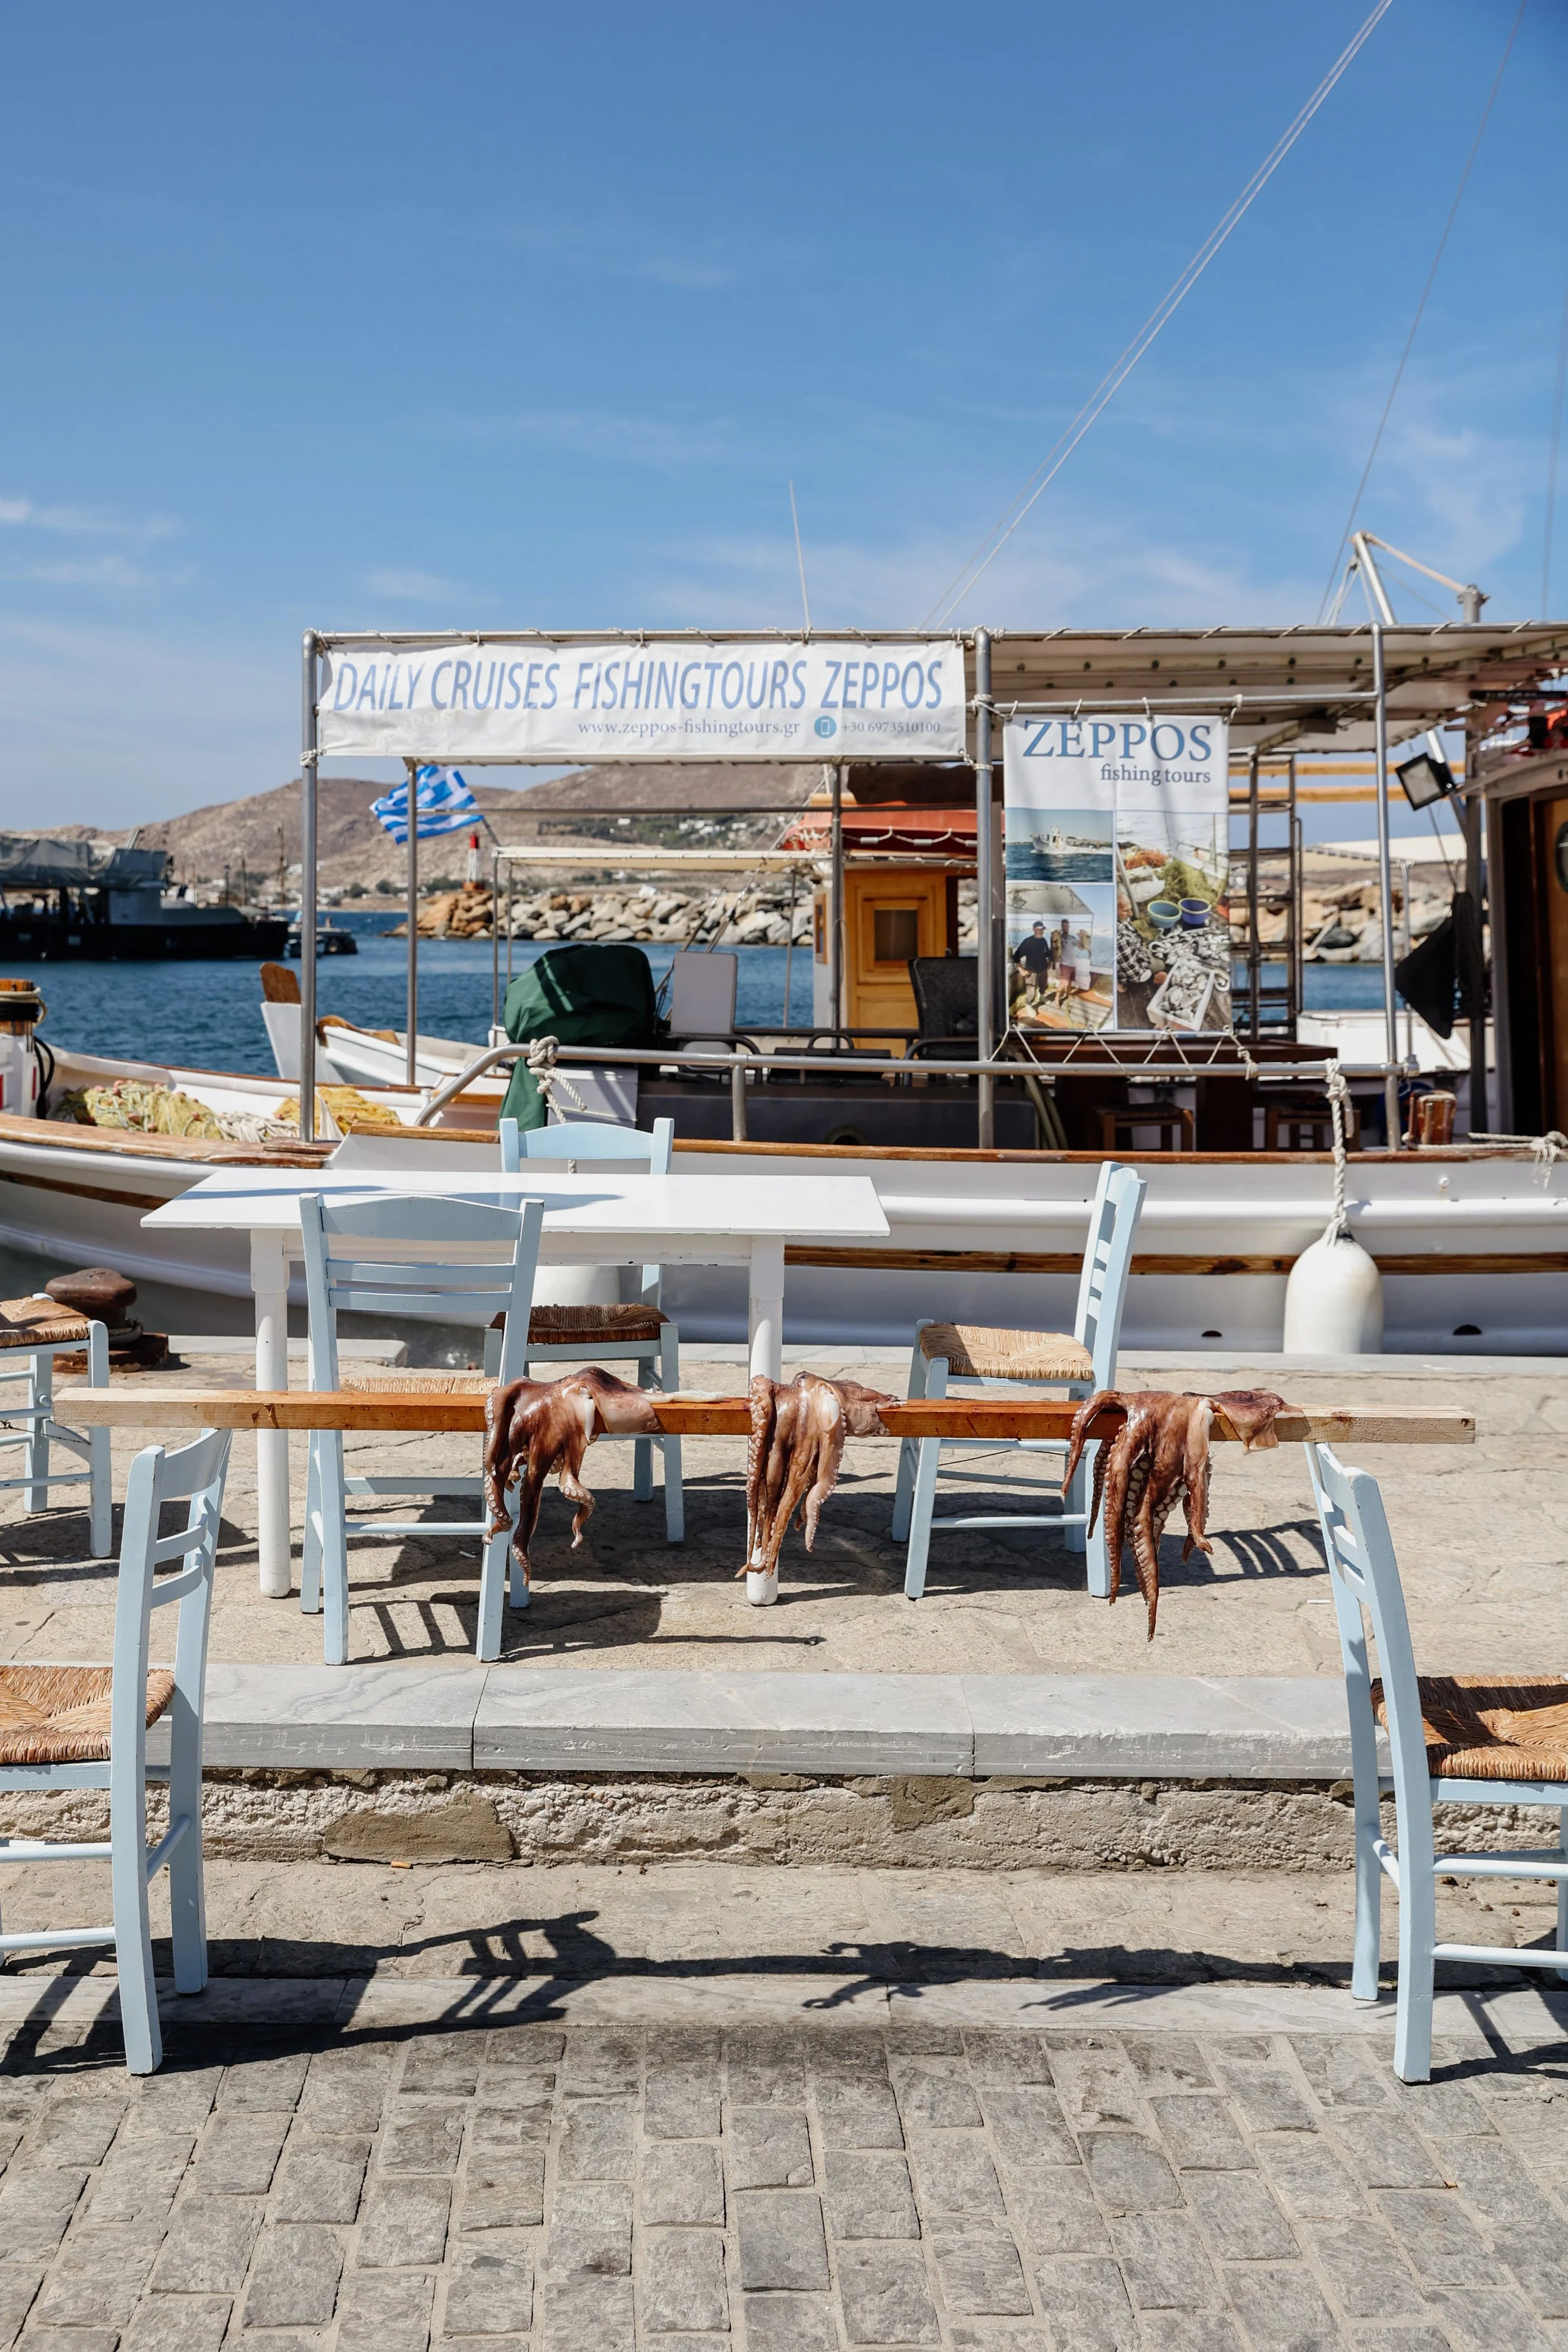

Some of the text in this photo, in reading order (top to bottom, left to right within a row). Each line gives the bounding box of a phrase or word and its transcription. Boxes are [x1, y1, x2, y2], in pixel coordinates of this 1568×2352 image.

[333, 660, 943, 711] DAILY CRUISES FISHINGTOURS ZEPPOS
[578, 719, 801, 738] www.zeppos-fishingtours.gr
[841, 721, 941, 733] +30 6973510100
[1022, 720, 1212, 761] ZEPPOS
[1100, 763, 1211, 787] fishing tours
